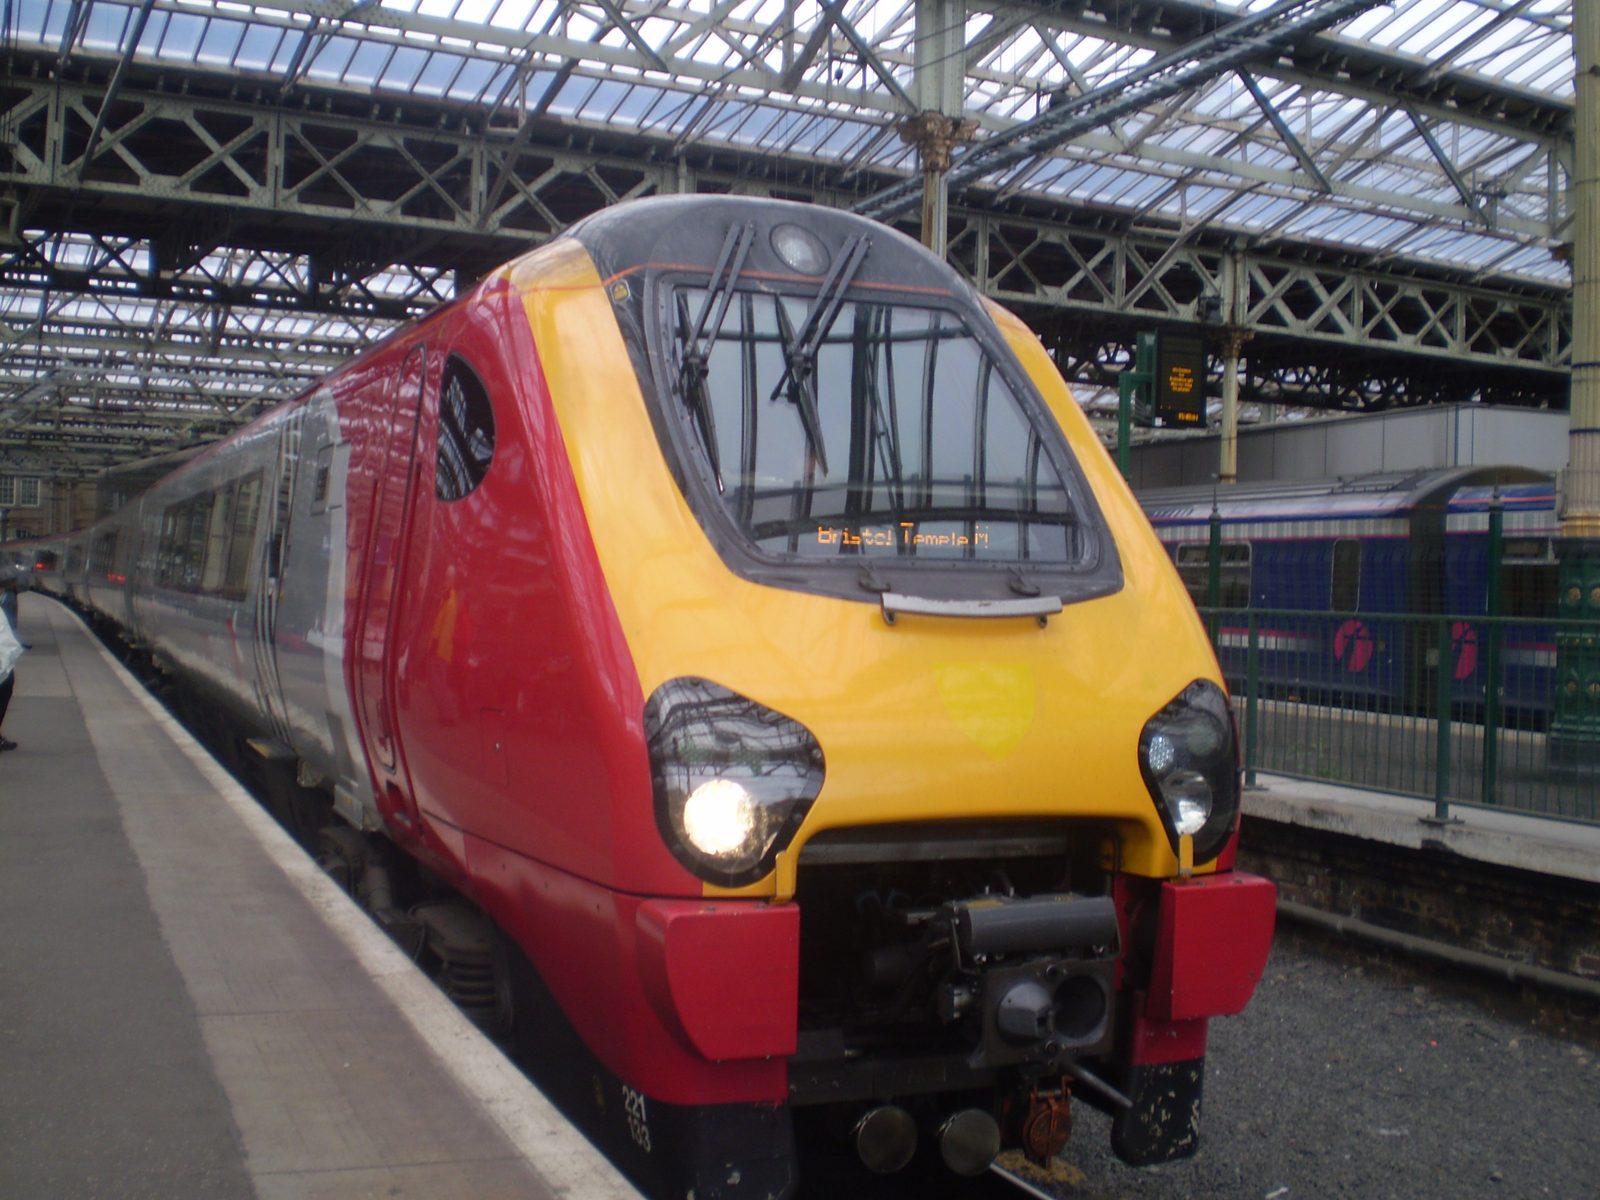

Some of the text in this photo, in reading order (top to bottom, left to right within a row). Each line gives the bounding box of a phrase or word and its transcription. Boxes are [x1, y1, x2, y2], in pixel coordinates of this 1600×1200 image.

[817, 526, 892, 546] Bristol
[900, 522, 969, 546] Temple
[622, 1085, 646, 1122] 221
[628, 1115, 651, 1153] 133
